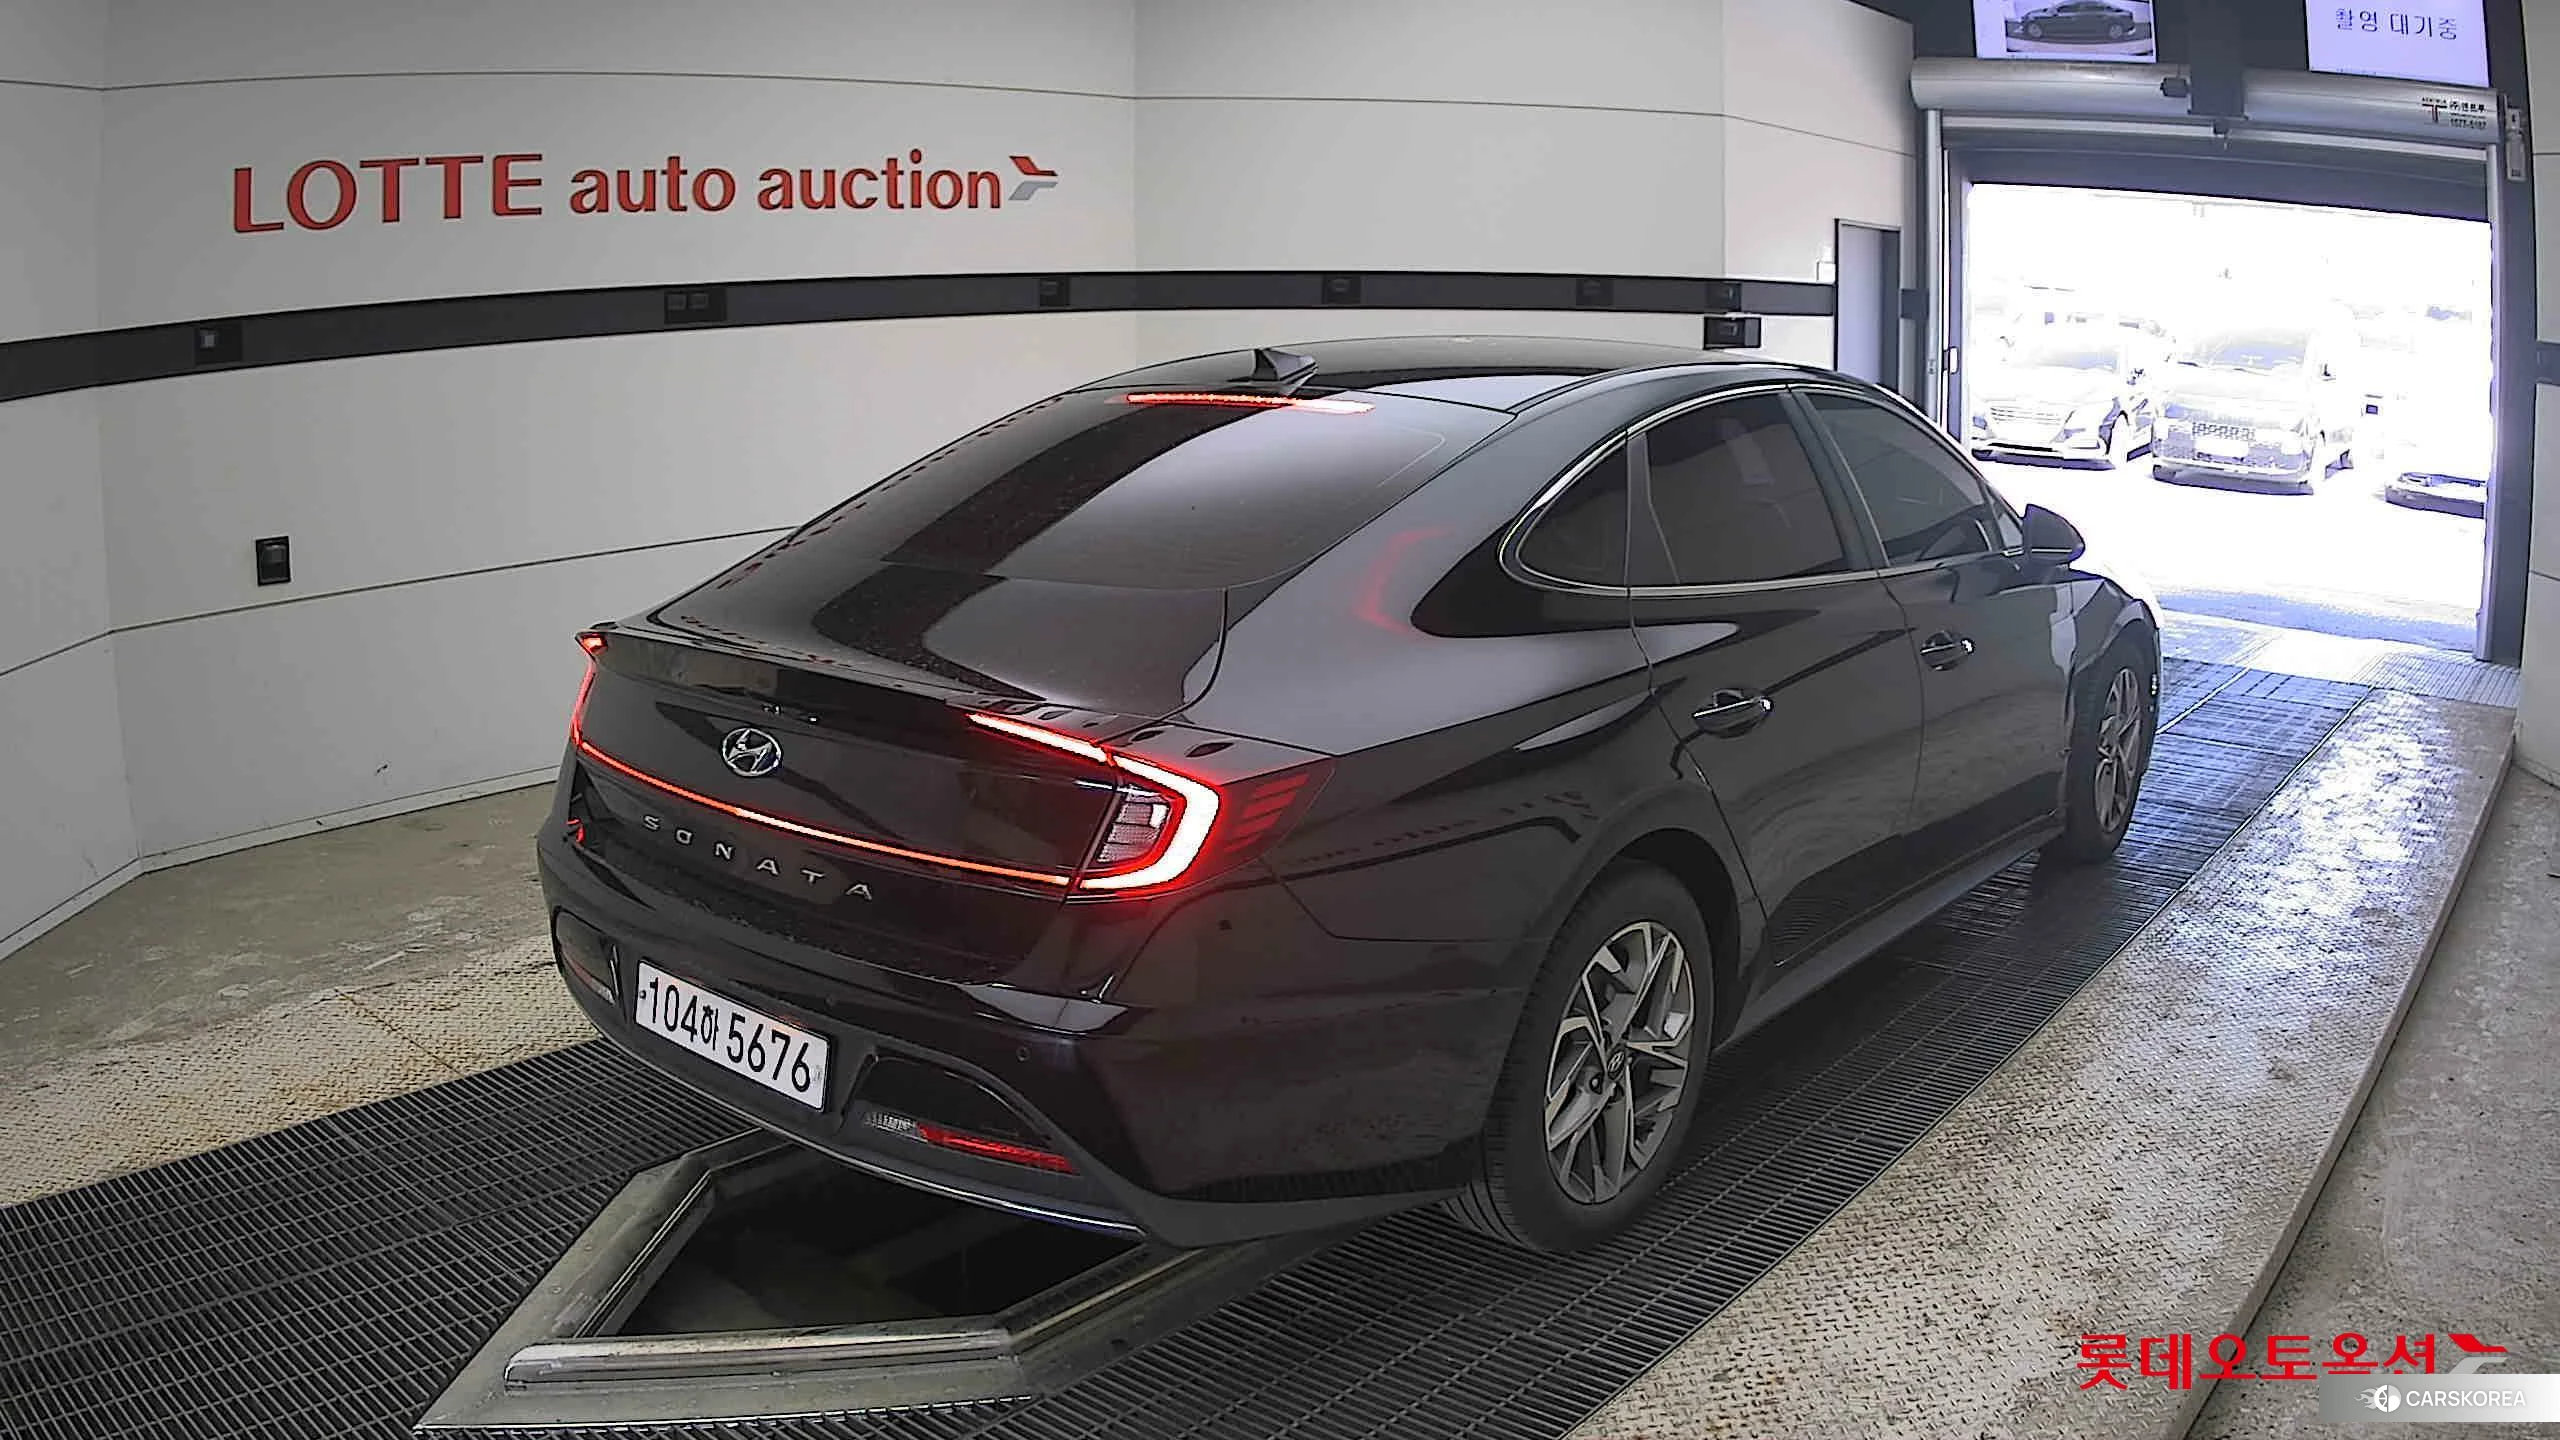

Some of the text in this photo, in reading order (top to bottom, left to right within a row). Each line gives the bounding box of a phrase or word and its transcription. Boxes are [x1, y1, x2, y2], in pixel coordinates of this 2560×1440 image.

[2336, 7, 2457, 41] 촬영 대기중
[234, 149, 1002, 233] LOTTE auto auction
[643, 814, 873, 901] SONATA
[649, 976, 812, 1093] 104하 5676
